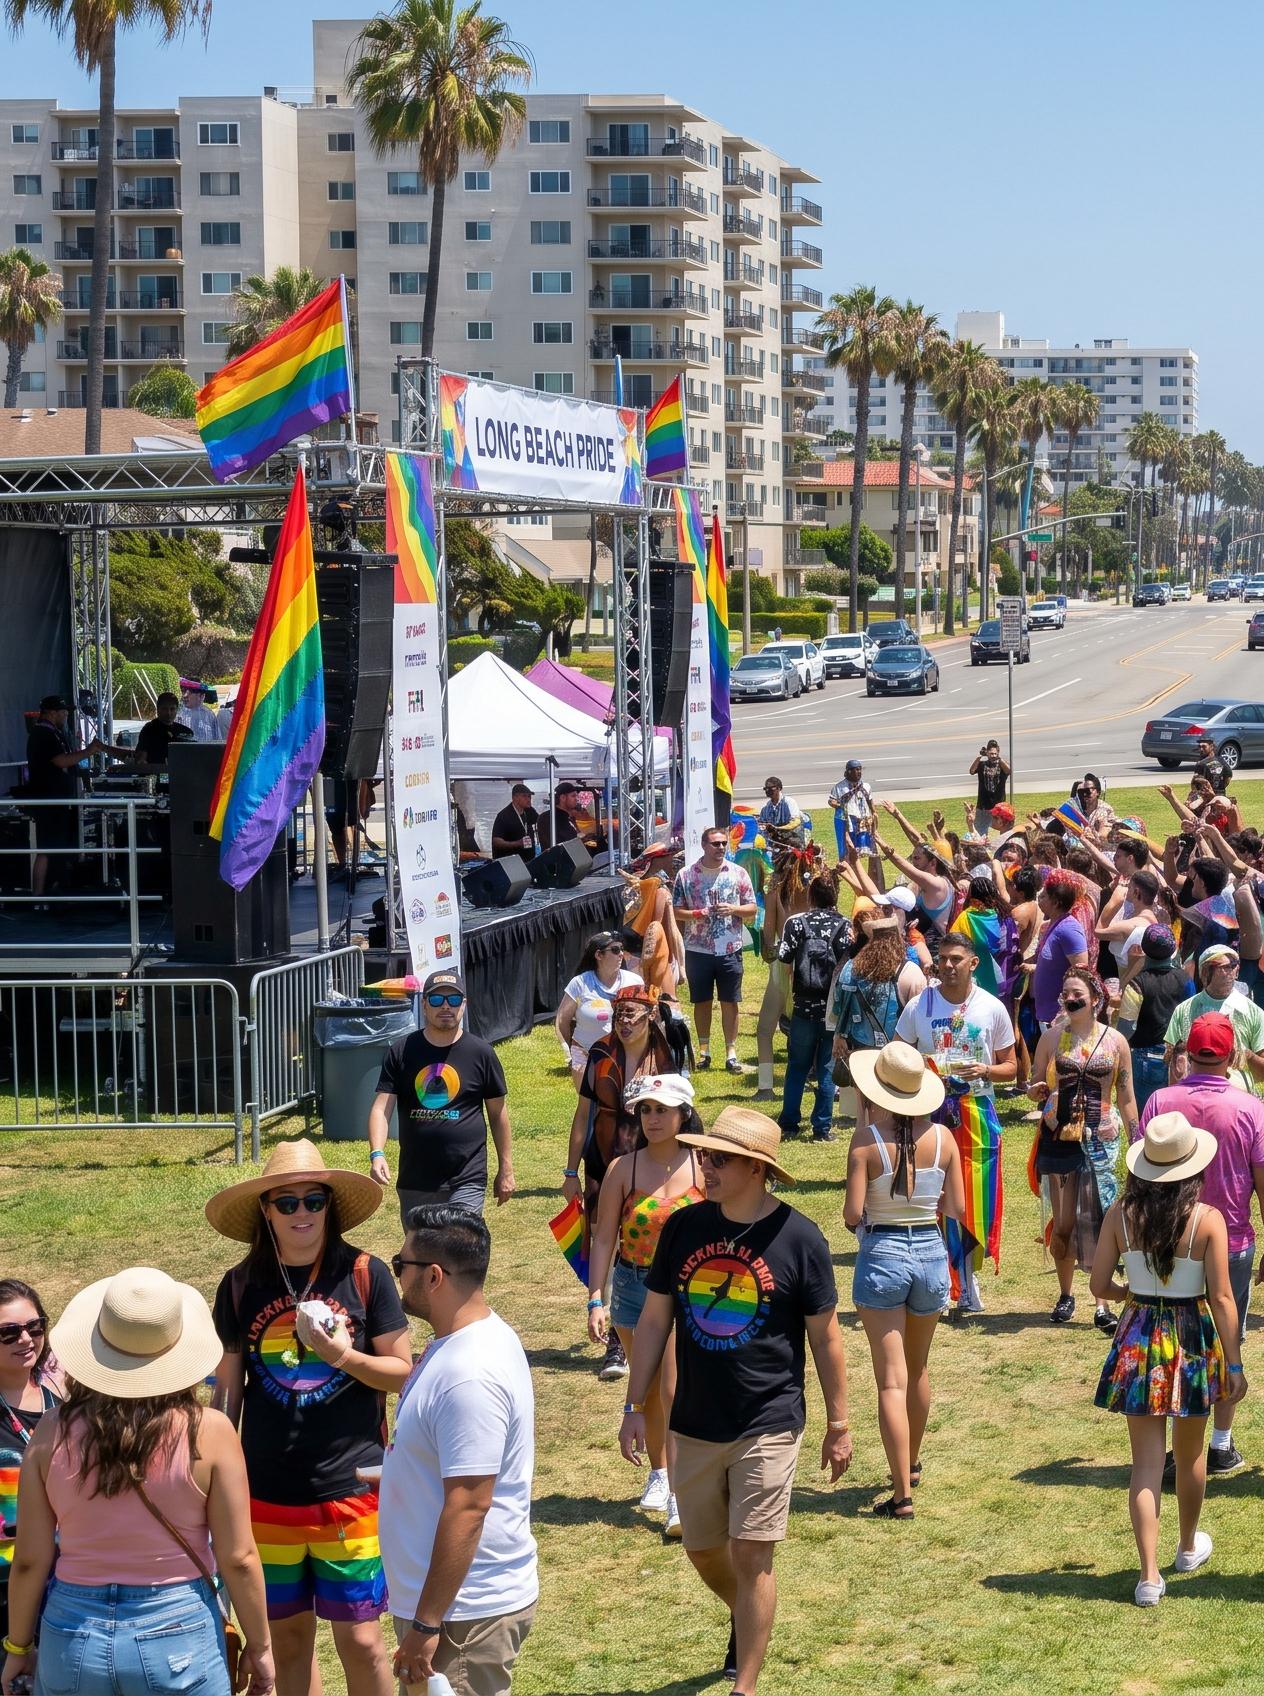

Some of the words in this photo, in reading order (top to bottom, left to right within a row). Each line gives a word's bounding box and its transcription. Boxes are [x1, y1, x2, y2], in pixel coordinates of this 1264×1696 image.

[475, 417, 520, 462] LONG
[524, 425, 575, 469] BEACH
[576, 434, 616, 474] PRIDE
